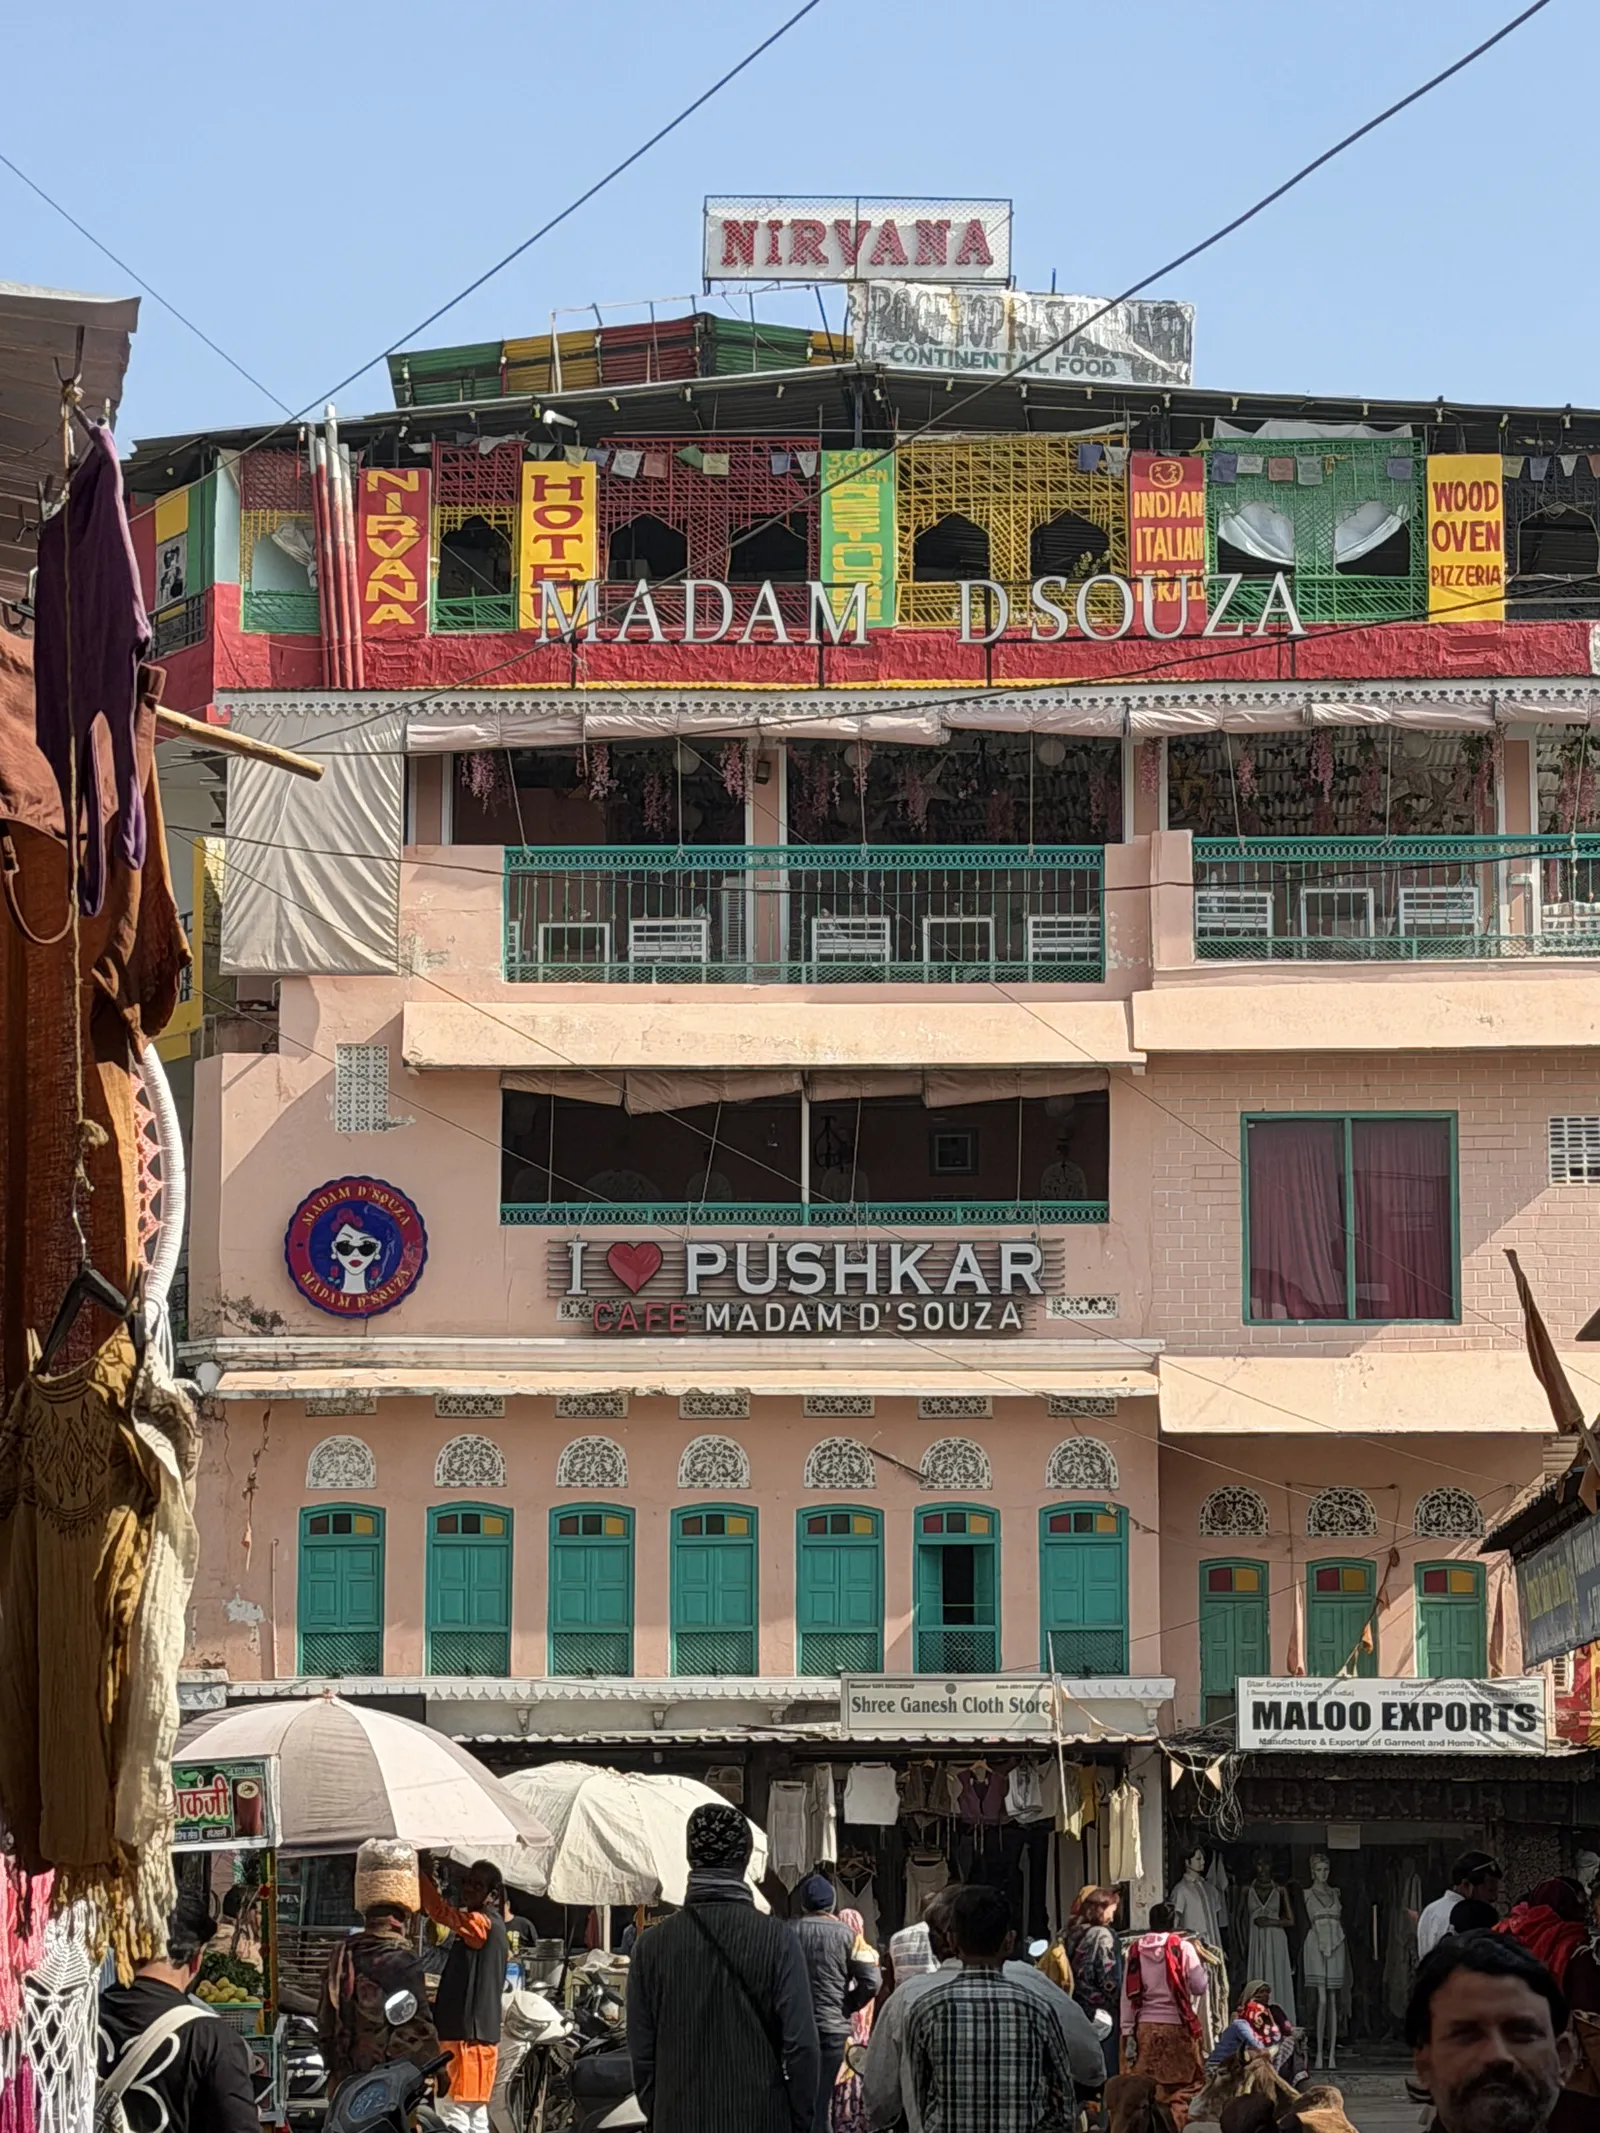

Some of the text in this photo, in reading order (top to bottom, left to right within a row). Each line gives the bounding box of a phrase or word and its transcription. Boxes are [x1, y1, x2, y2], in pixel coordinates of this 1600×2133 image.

[721, 219, 994, 266] NIRVANA
[1055, 356, 1118, 377] FOOD
[1133, 490, 1205, 519] INDIAN
[1432, 480, 1499, 512] WOOD
[365, 470, 421, 625] NIRVANA
[529, 474, 586, 620] HOTEL
[1135, 526, 1205, 563] ITALIAN
[1431, 519, 1501, 553] OVEN
[1431, 564, 1502, 587] PIZZERIA
[535, 571, 1310, 647] MADAM DSOUZA
[301, 1185, 351, 1227] MADAM
[565, 1240, 1045, 1297] I PUSHKAR
[301, 1270, 351, 1309] MADAM
[592, 1301, 1023, 1333] CAFE MADAM D'SOUZA
[851, 1696, 1051, 1714] Shree Ganesh Cloth Store
[1252, 1701, 1537, 1733] MALOO EXPORTS
[1258, 1737, 1317, 1746] Manufacture
[1328, 1738, 1369, 1747] Exporter
[1372, 1739, 1381, 1747] of
[1384, 1739, 1425, 1747] Garment
[1428, 1739, 1445, 1747] and
